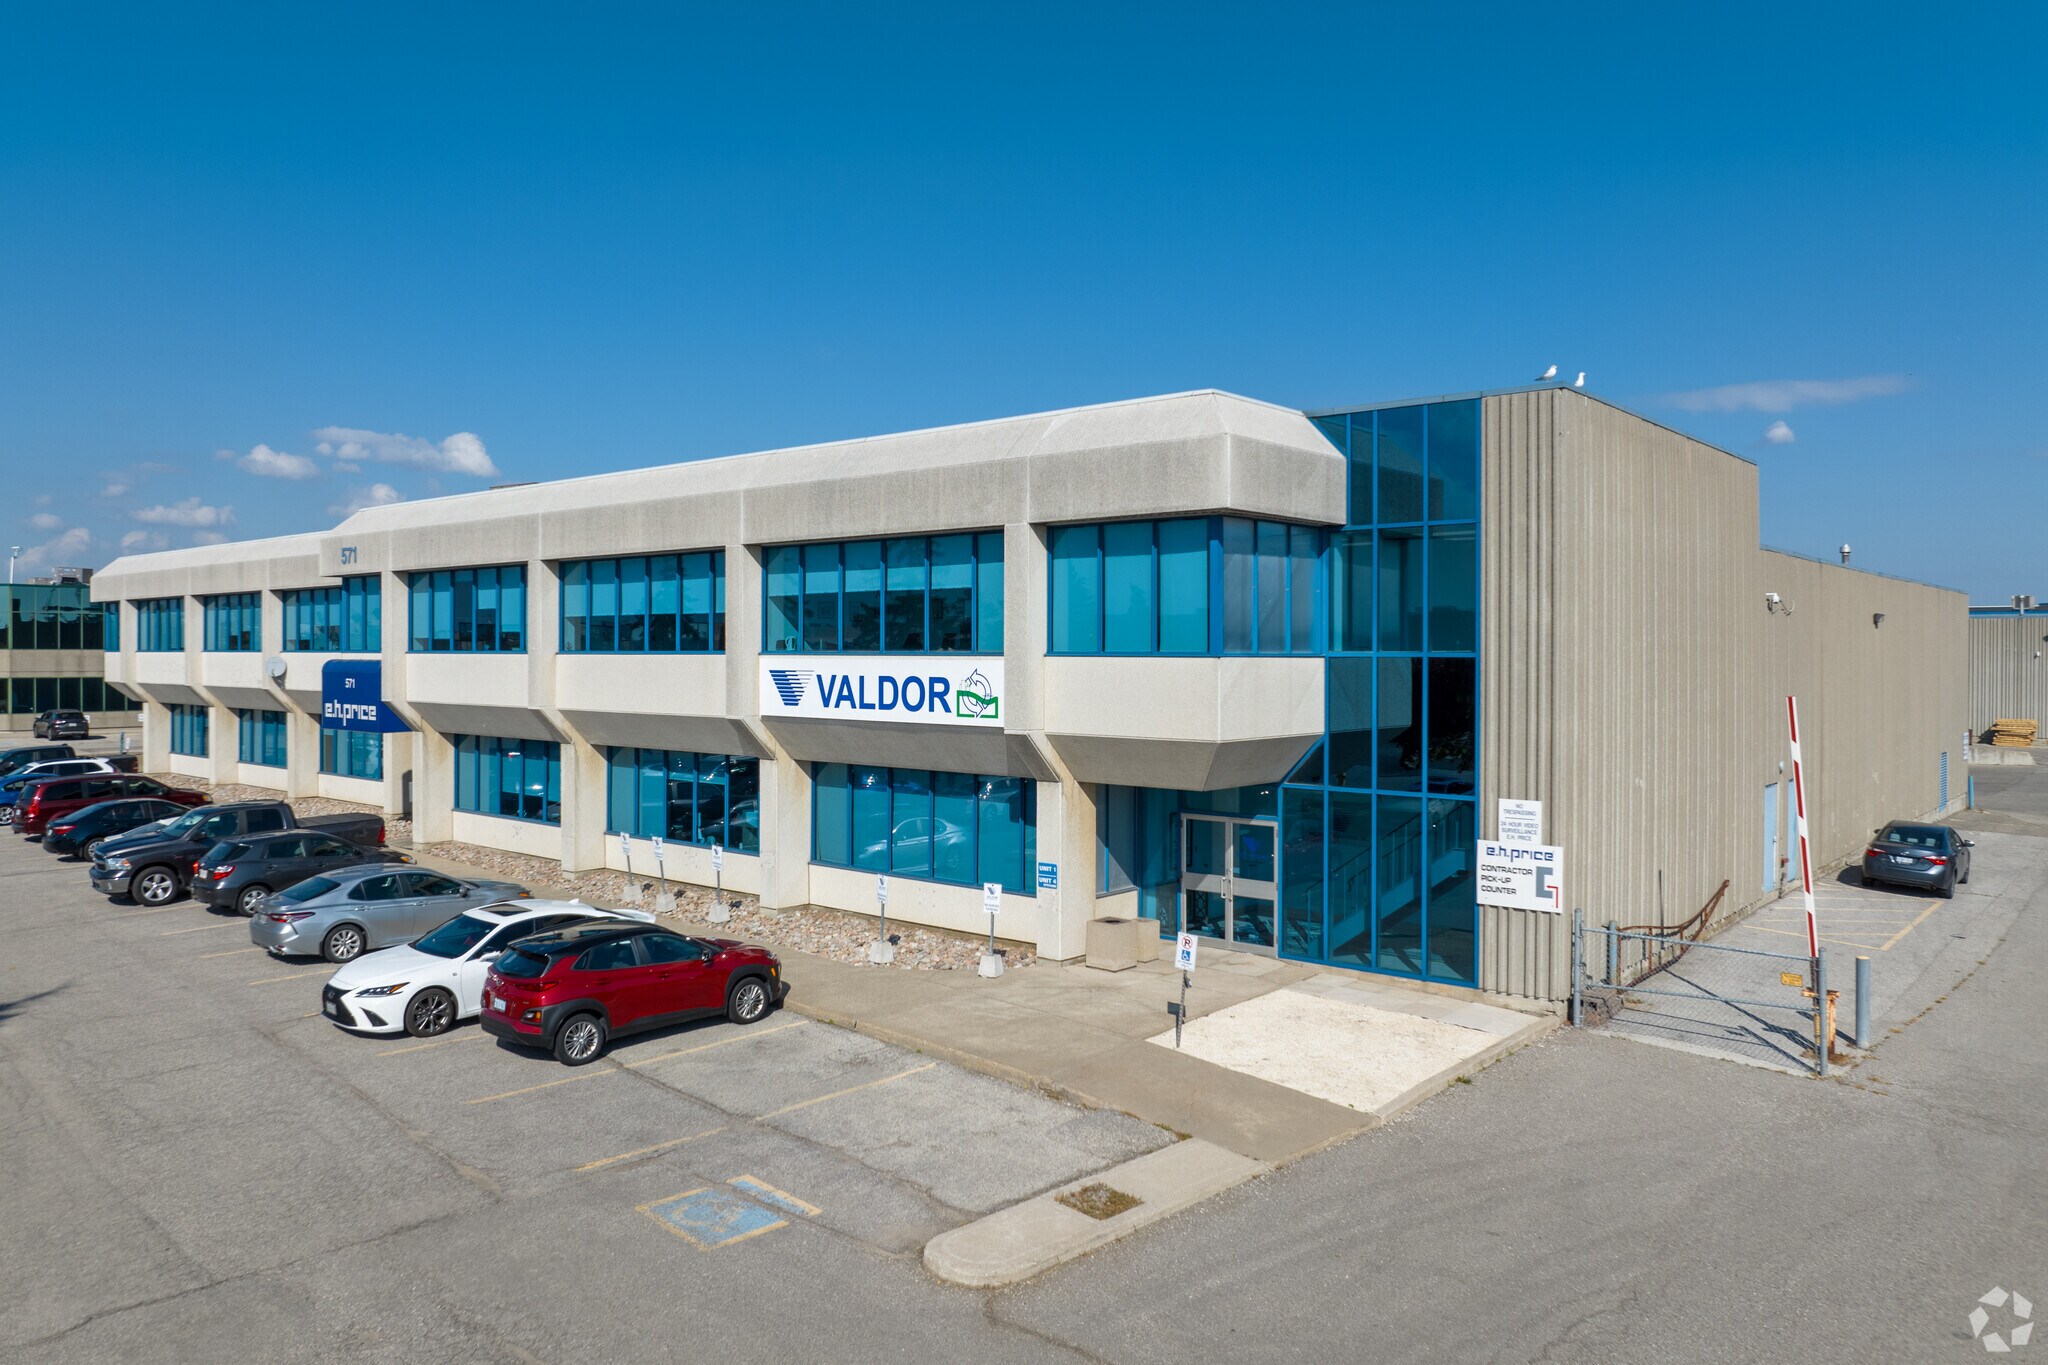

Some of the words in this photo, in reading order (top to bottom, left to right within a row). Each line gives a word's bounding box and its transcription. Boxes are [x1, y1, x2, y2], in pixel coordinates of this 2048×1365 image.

[341, 546, 357, 565] 571
[345, 678, 356, 688] 571
[816, 674, 952, 713] VALDOR
[1501, 827, 1537, 835] SURVEILLANCE
[1486, 846, 1553, 862] e.h.price
[1481, 864, 1533, 875] CONTRACTOR
[1481, 875, 1511, 884] PICK-UP
[1481, 885, 1517, 895] COUNTER
